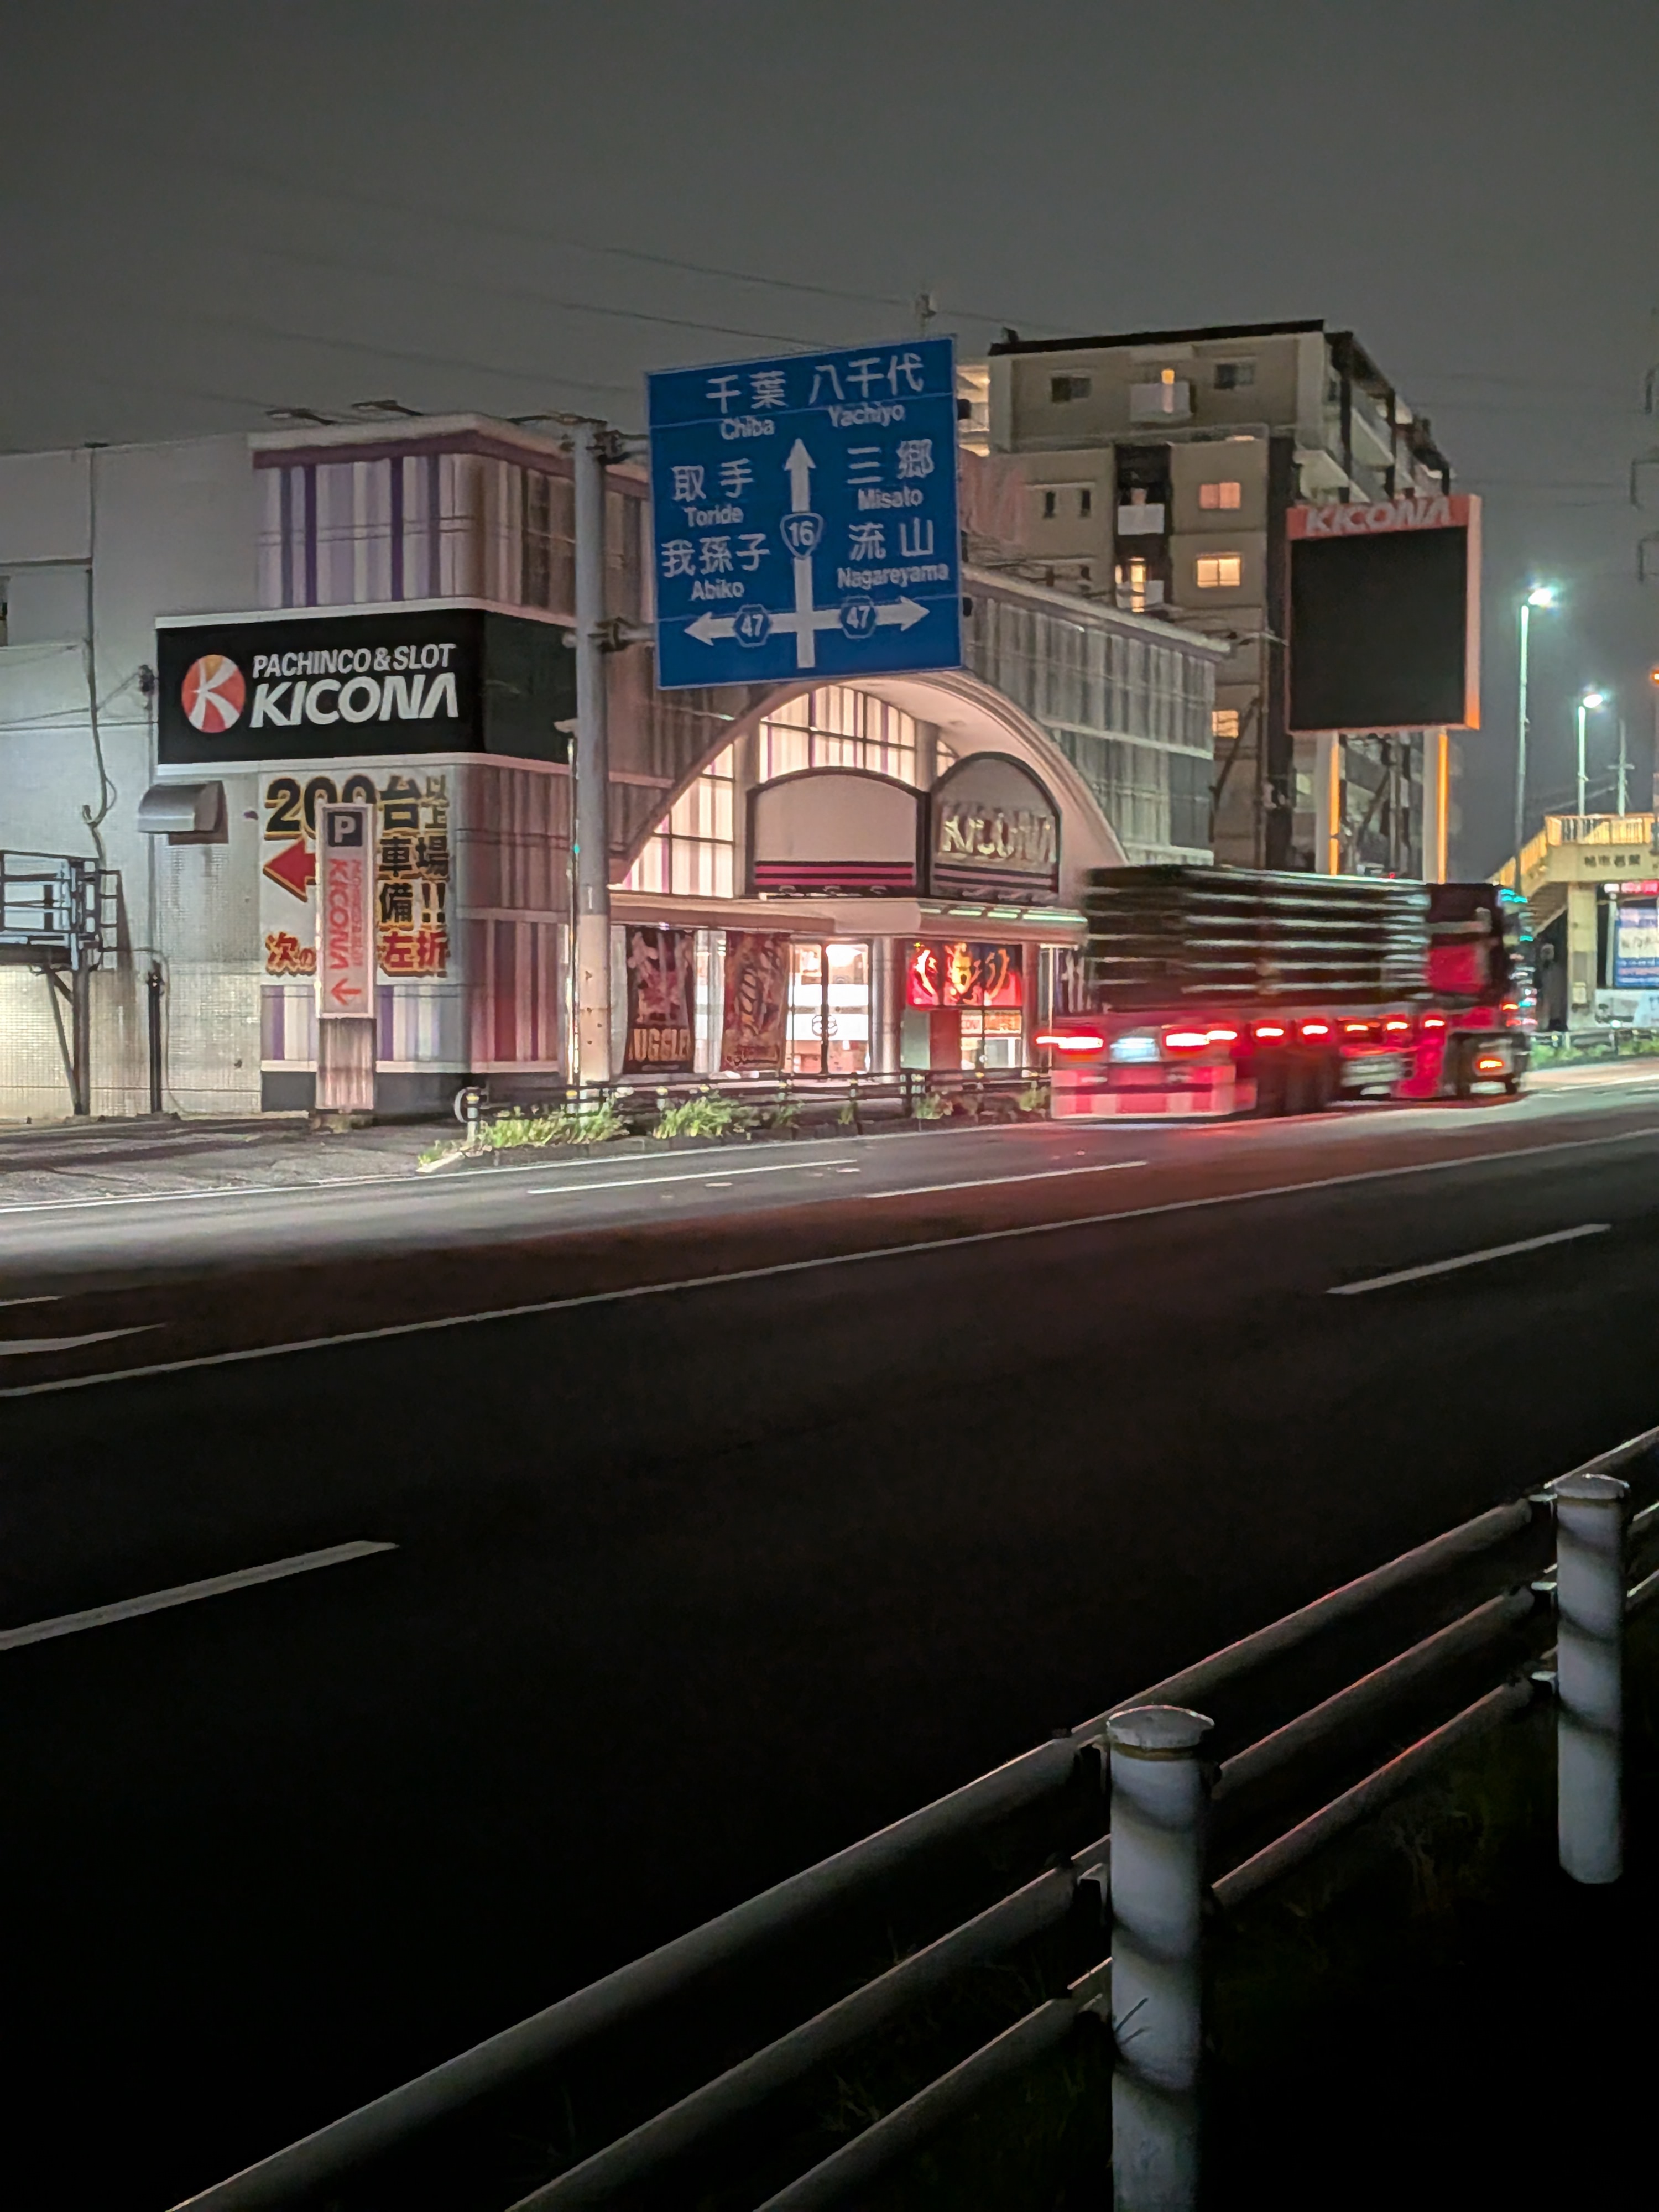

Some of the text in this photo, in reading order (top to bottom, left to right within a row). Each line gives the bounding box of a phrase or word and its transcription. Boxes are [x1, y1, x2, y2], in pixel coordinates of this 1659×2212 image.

[706, 371, 786, 413] 千葉
[808, 353, 924, 405] 八千代
[720, 417, 775, 440] Chiba
[829, 402, 905, 428] Yachiyo
[847, 439, 935, 484] 三郷
[671, 458, 754, 501] 取手
[858, 487, 923, 510] Misato
[684, 505, 744, 528] Toride
[1305, 498, 1451, 535] KICONA
[789, 521, 814, 546] 16
[849, 518, 934, 560] 流山
[661, 533, 770, 578] 我孫子
[691, 578, 744, 600] Abiko
[837, 563, 948, 590] Nagareyama
[741, 614, 764, 637] 47
[847, 606, 870, 629] 47
[249, 672, 459, 728] KICONA
[334, 815, 356, 843] P
[377, 930, 450, 972] 左折
